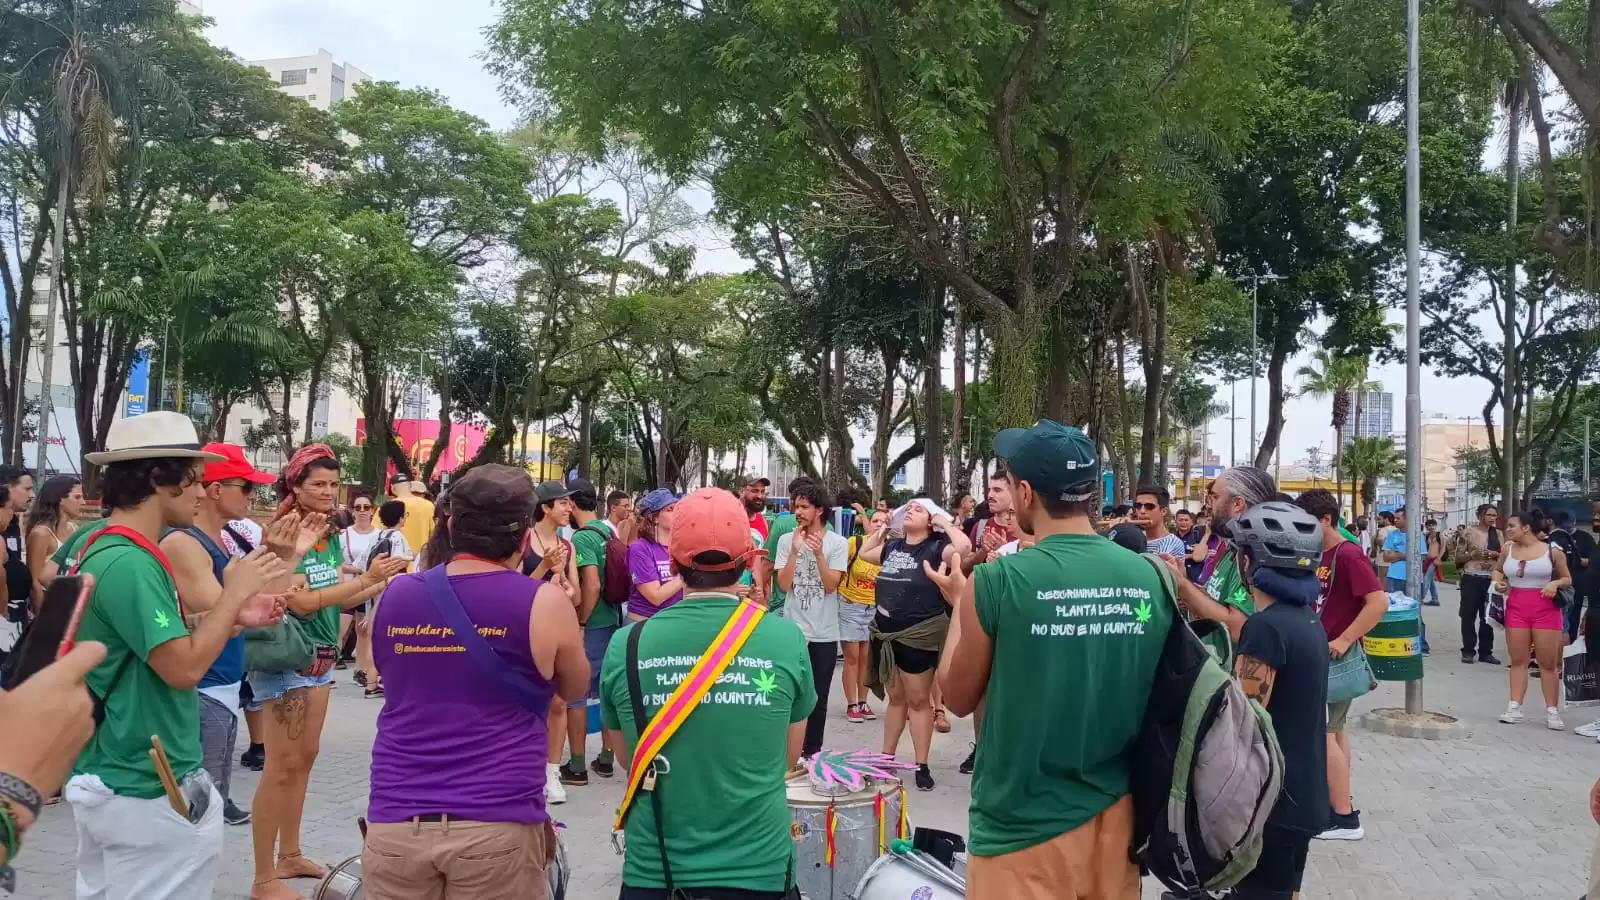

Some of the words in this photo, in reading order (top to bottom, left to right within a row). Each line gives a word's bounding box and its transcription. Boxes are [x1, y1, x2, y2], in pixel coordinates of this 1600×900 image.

[1116, 588, 1121, 599] O
[1056, 604, 1096, 617] PLANTA
[1098, 603, 1133, 616] LEGAL
[1031, 623, 1048, 636] NO
[1077, 624, 1088, 636] E
[1089, 623, 1102, 635] NO
[1103, 622, 1145, 635] QUINTAL
[656, 672, 690, 685] PLAN
[715, 672, 750, 685] EGAL
[714, 692, 771, 705] QUINTAL
